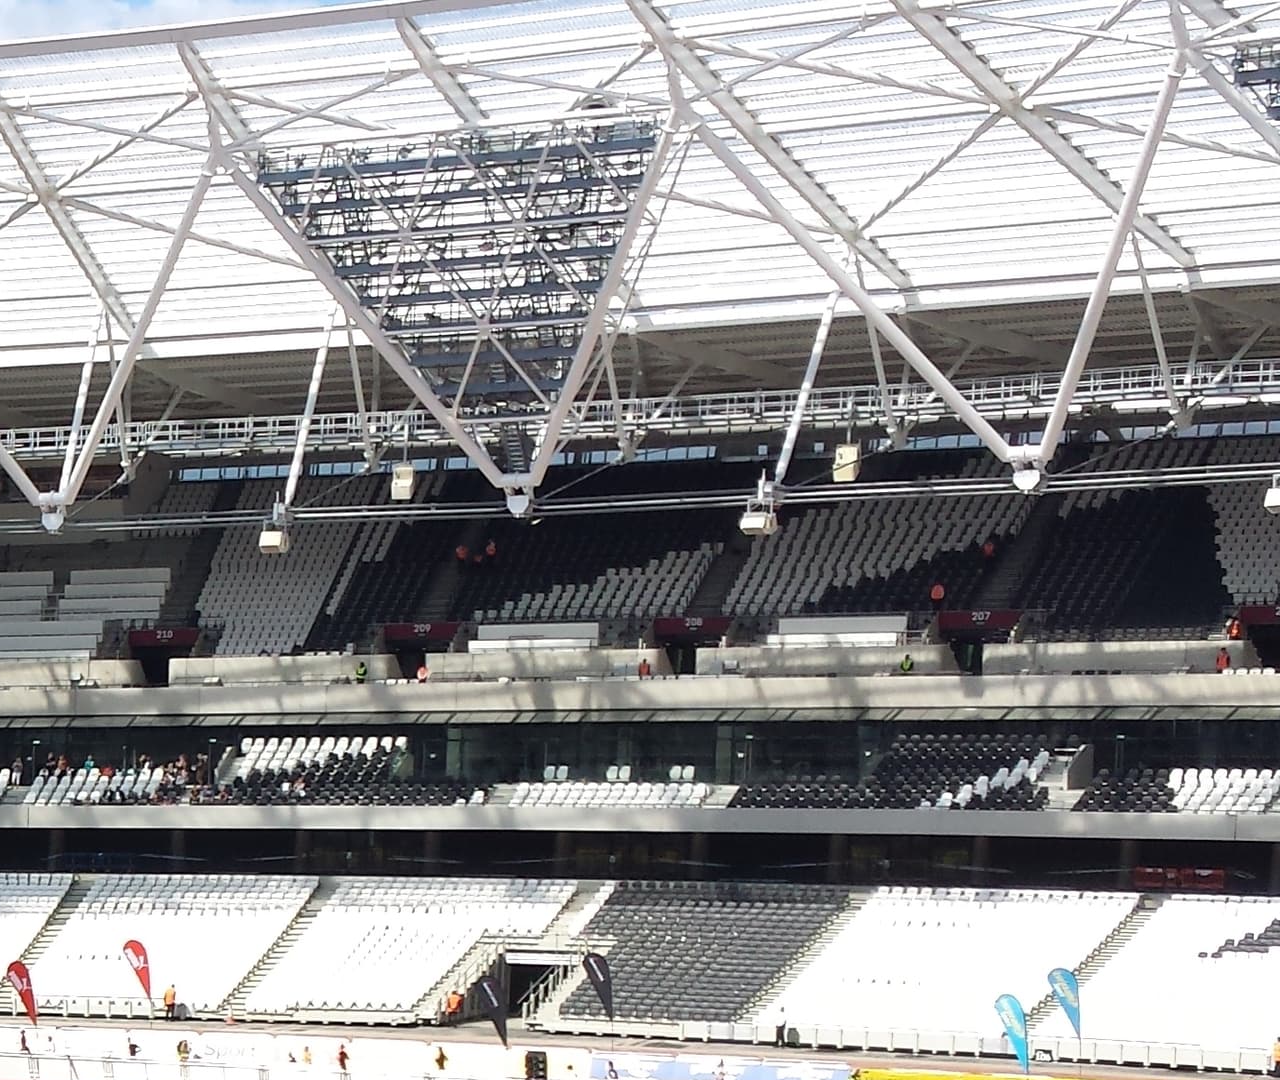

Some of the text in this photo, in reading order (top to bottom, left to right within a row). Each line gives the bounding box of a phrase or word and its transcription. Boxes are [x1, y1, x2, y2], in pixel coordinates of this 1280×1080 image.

[971, 611, 991, 621] 207
[413, 623, 431, 632] 209
[156, 630, 174, 638] 210
